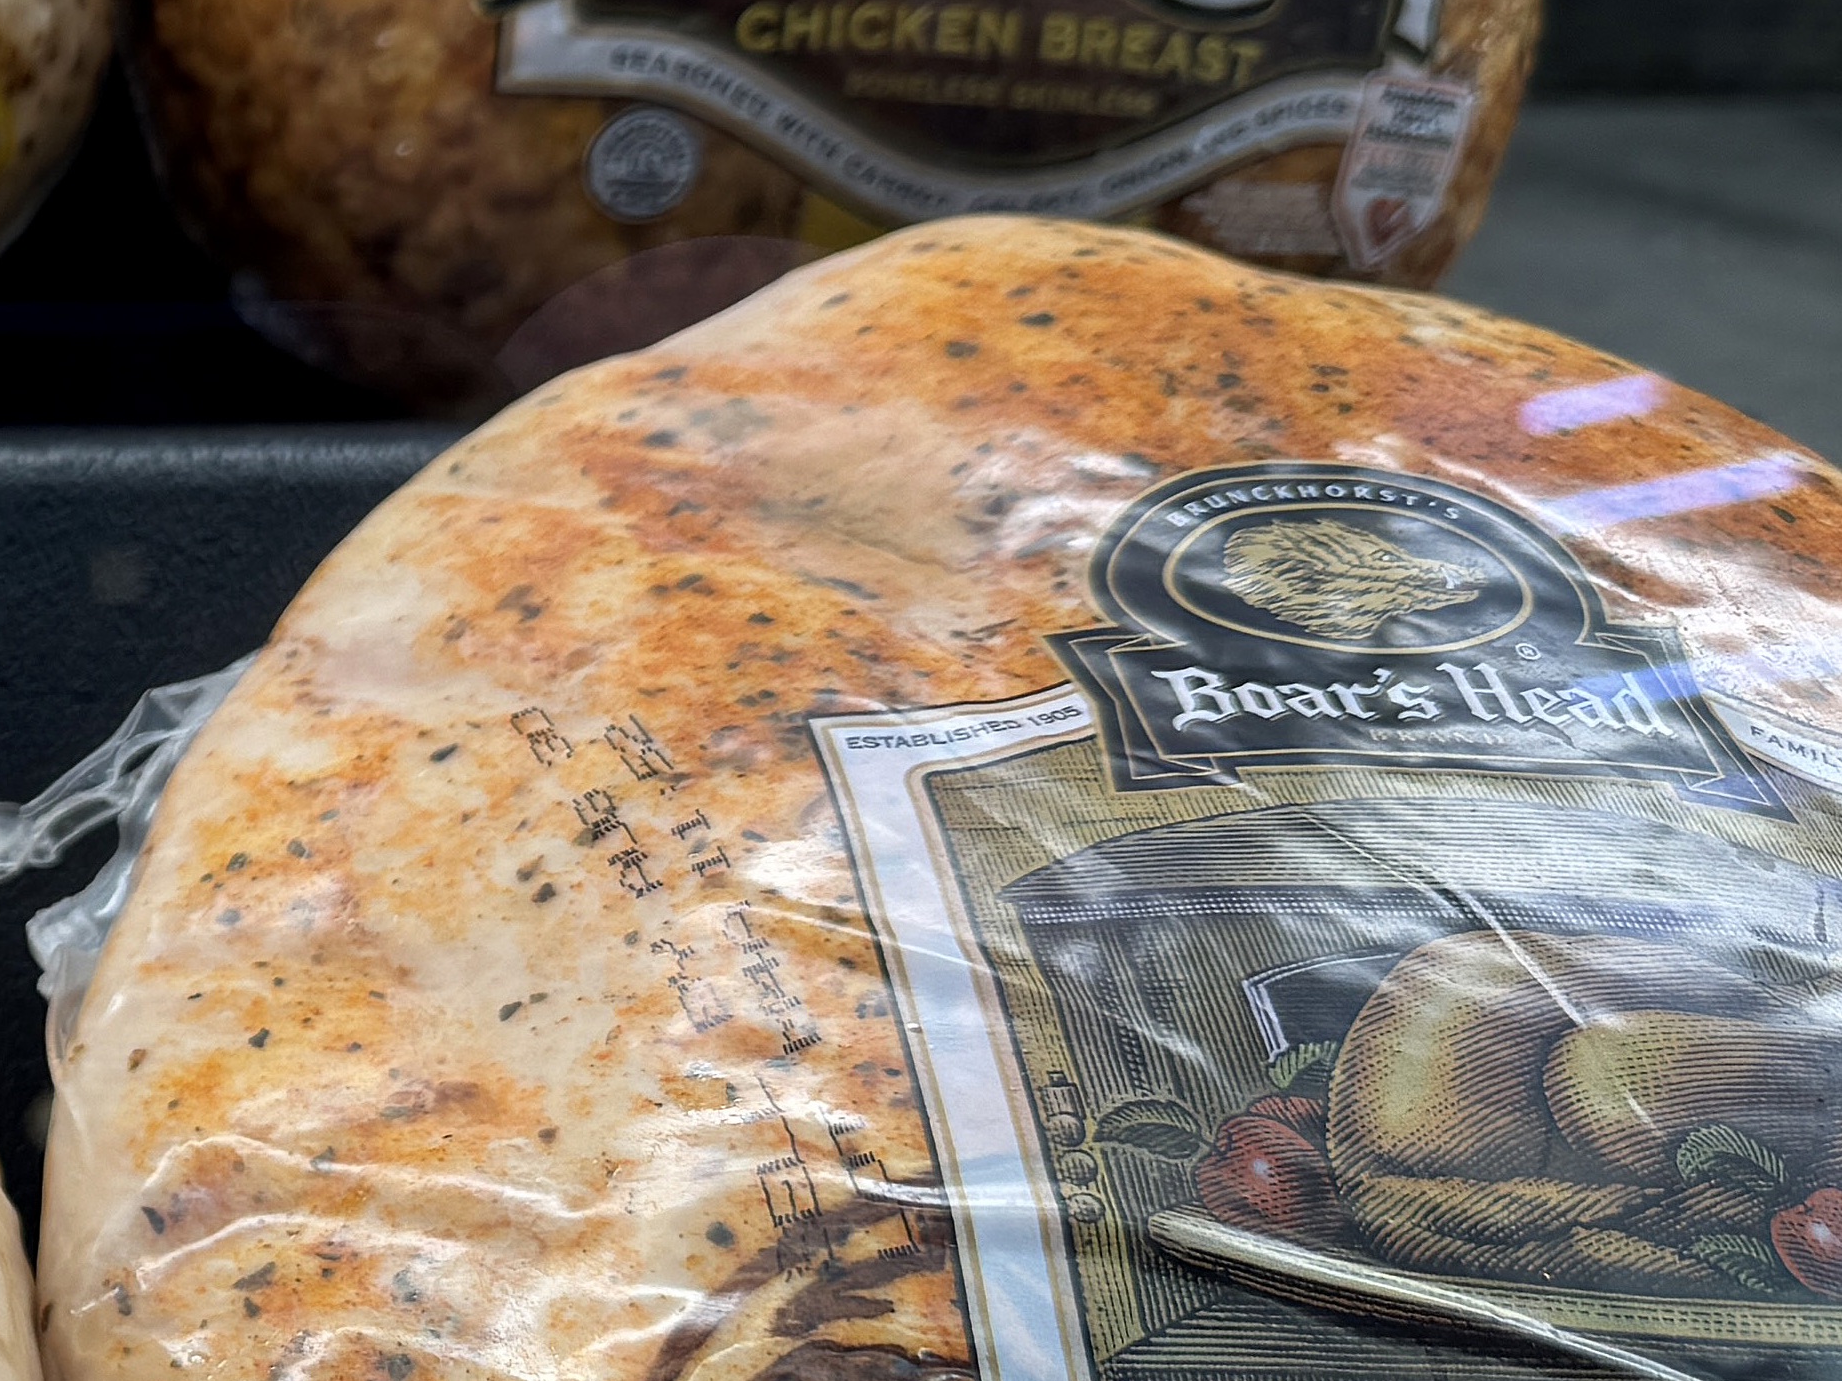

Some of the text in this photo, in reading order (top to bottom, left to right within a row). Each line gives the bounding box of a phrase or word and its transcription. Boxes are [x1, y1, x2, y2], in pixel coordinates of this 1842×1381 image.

[735, 0, 1265, 90] CHICKEN BREAST
[1168, 480, 1461, 529] BRUNCKHORST'S
[845, 705, 1079, 751] ESTABLISHED 1905
[1151, 662, 1677, 740] Boar's Head
